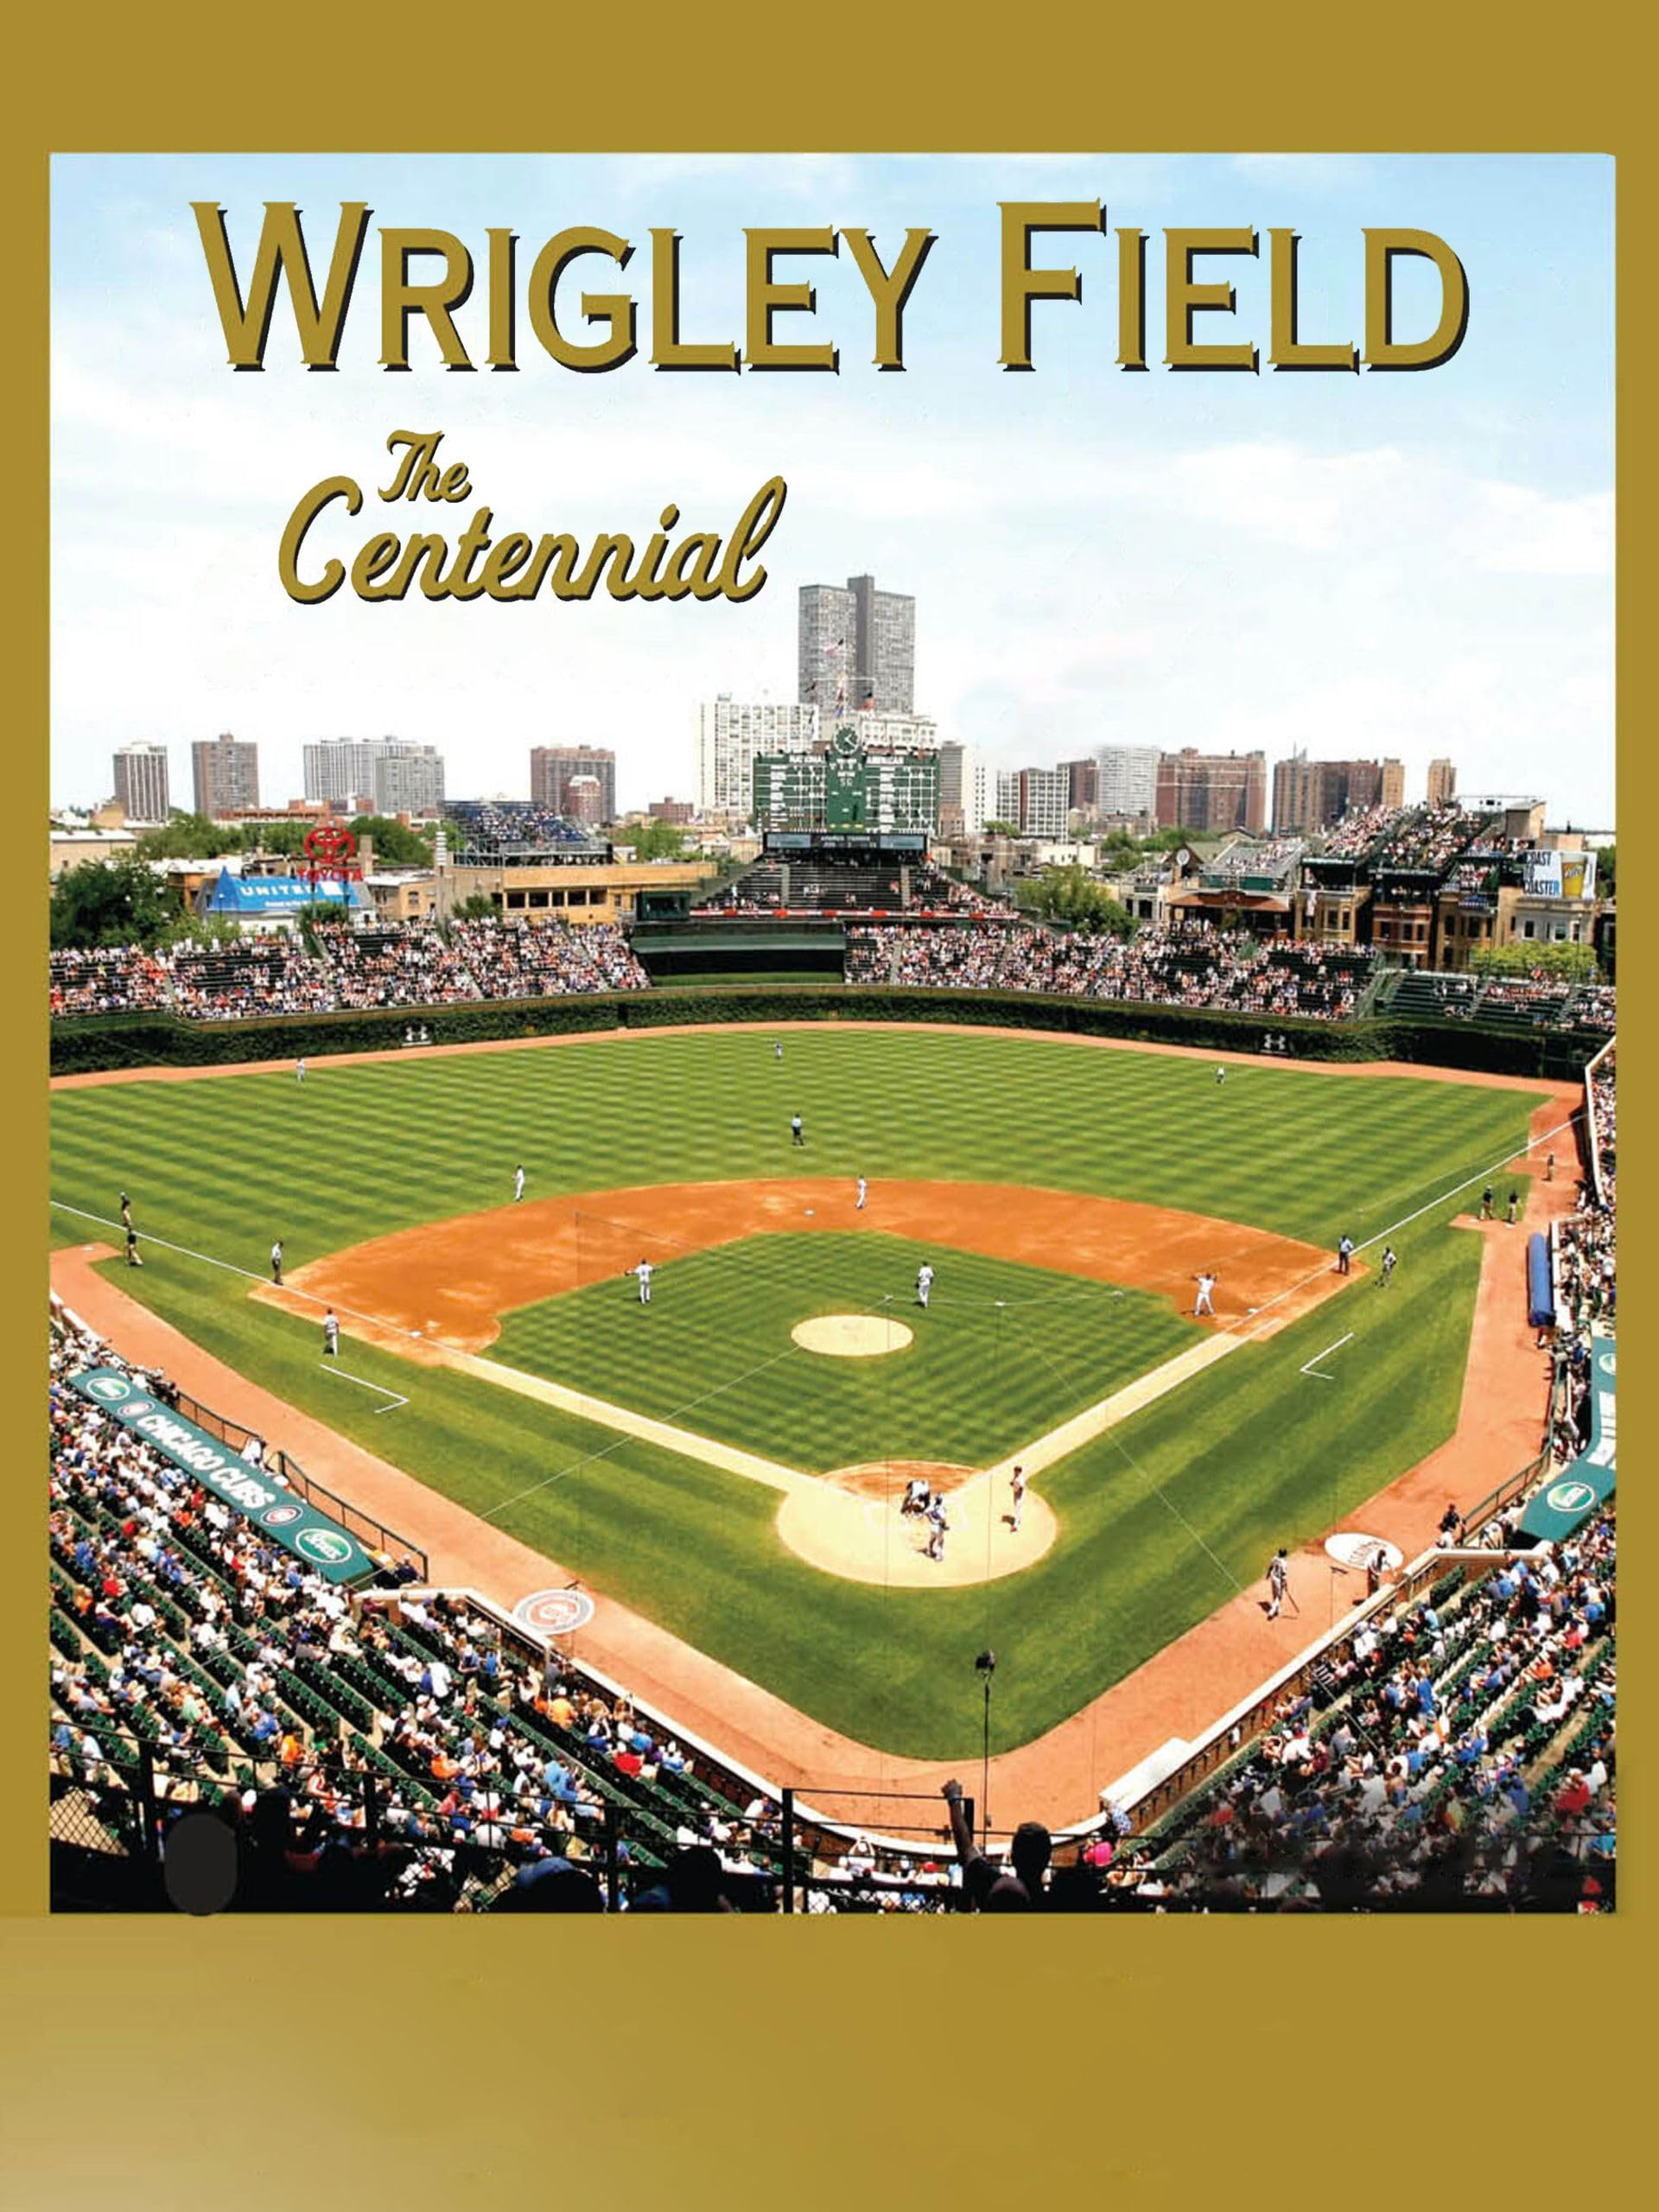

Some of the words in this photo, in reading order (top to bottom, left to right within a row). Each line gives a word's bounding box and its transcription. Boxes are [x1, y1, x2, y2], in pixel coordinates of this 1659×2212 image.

[296, 867, 364, 883] TOYOTA
[136, 1414, 226, 1470] CHICAGO
[209, 1466, 276, 1509] CUBS
